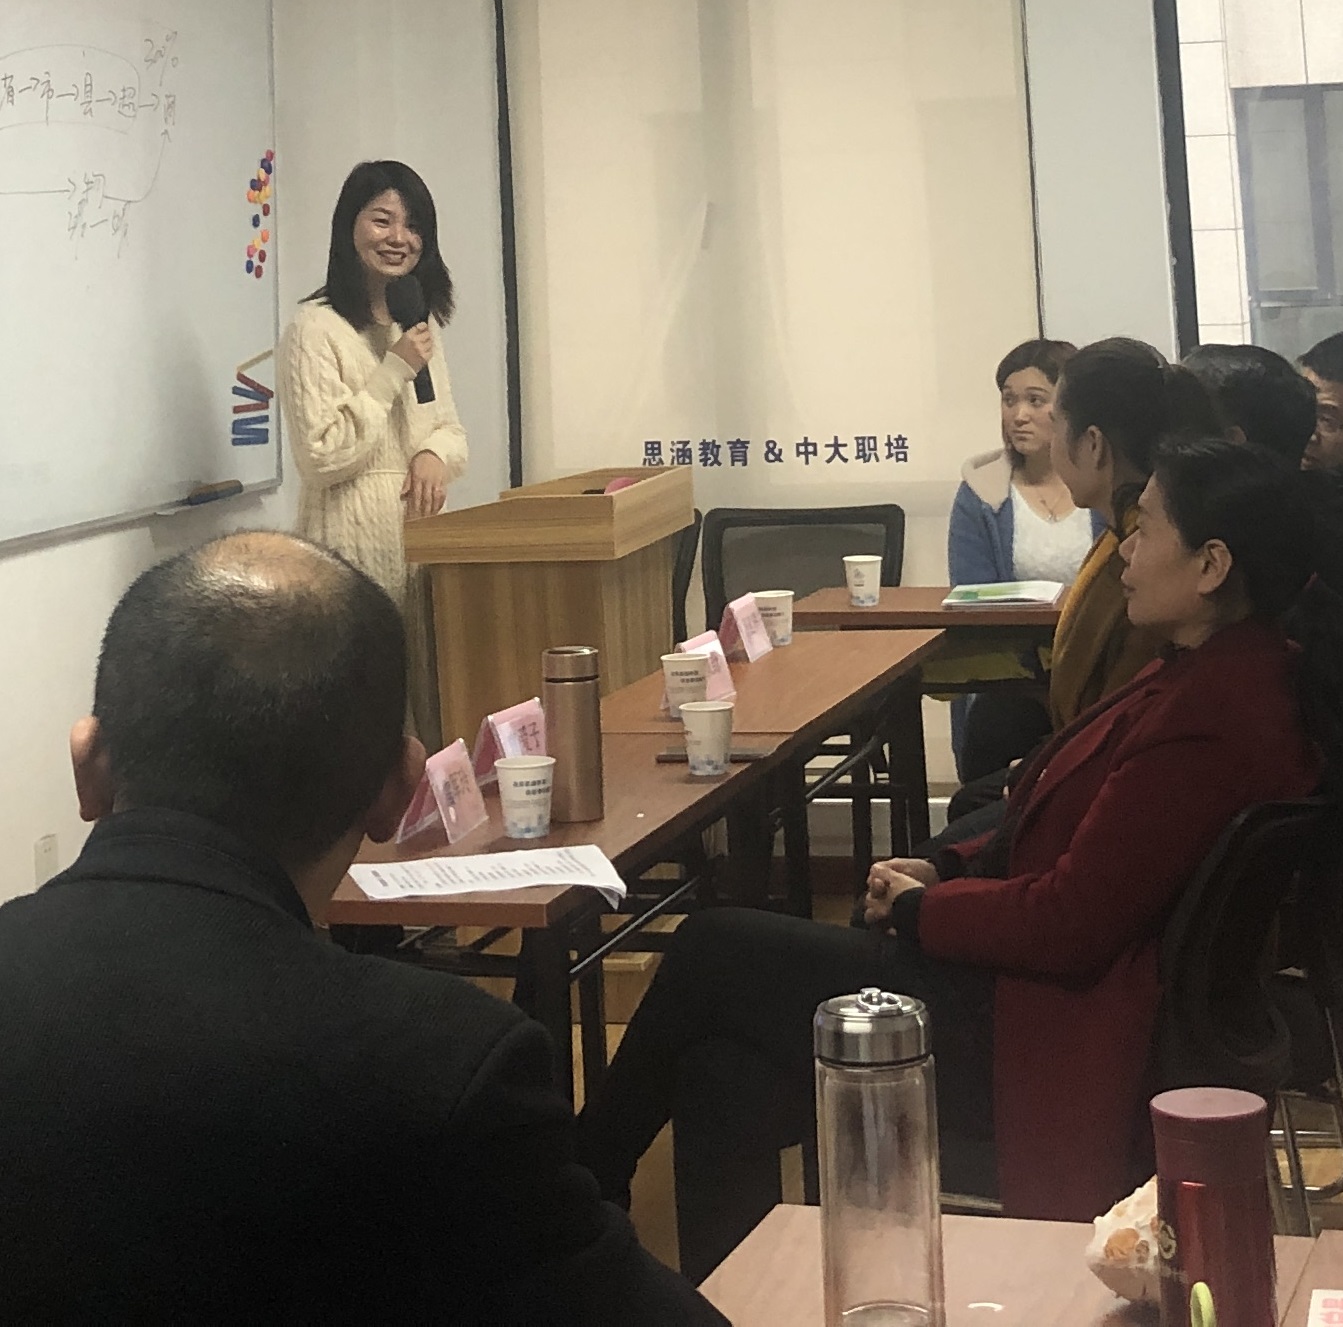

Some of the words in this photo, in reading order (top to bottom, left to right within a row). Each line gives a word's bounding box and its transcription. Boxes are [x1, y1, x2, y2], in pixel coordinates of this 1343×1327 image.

[642, 438, 750, 468] 思涵教育
[763, 439, 784, 465] &
[795, 434, 909, 466] 中大职培
